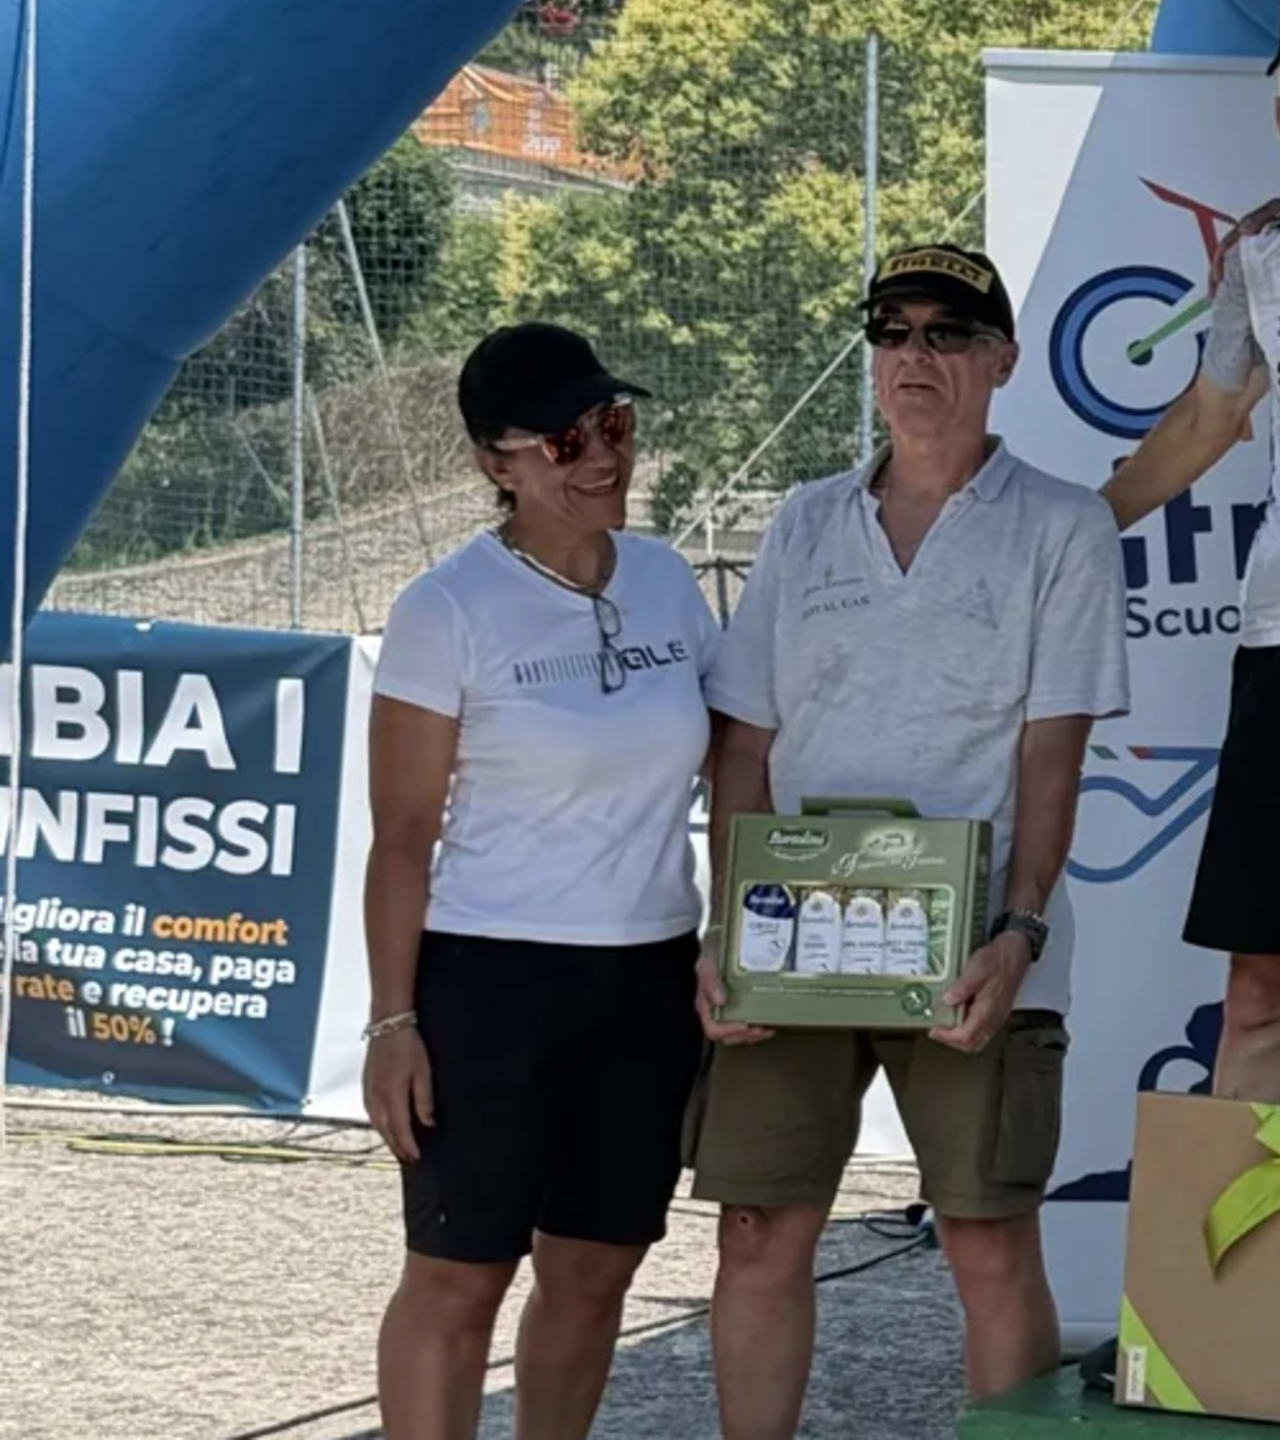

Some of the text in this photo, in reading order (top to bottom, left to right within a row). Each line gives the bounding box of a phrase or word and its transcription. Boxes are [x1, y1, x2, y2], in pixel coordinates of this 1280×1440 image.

[274, 677, 304, 775] I
[0, 785, 296, 876] NFISSI
[0, 896, 289, 946] gliora il comfort
[45, 935, 106, 970] tua
[114, 946, 203, 982] casa,
[209, 954, 297, 989] paga
[14, 974, 268, 1020] rate e recupera
[65, 1006, 87, 1038] il
[92, 1012, 156, 1045] 50%
